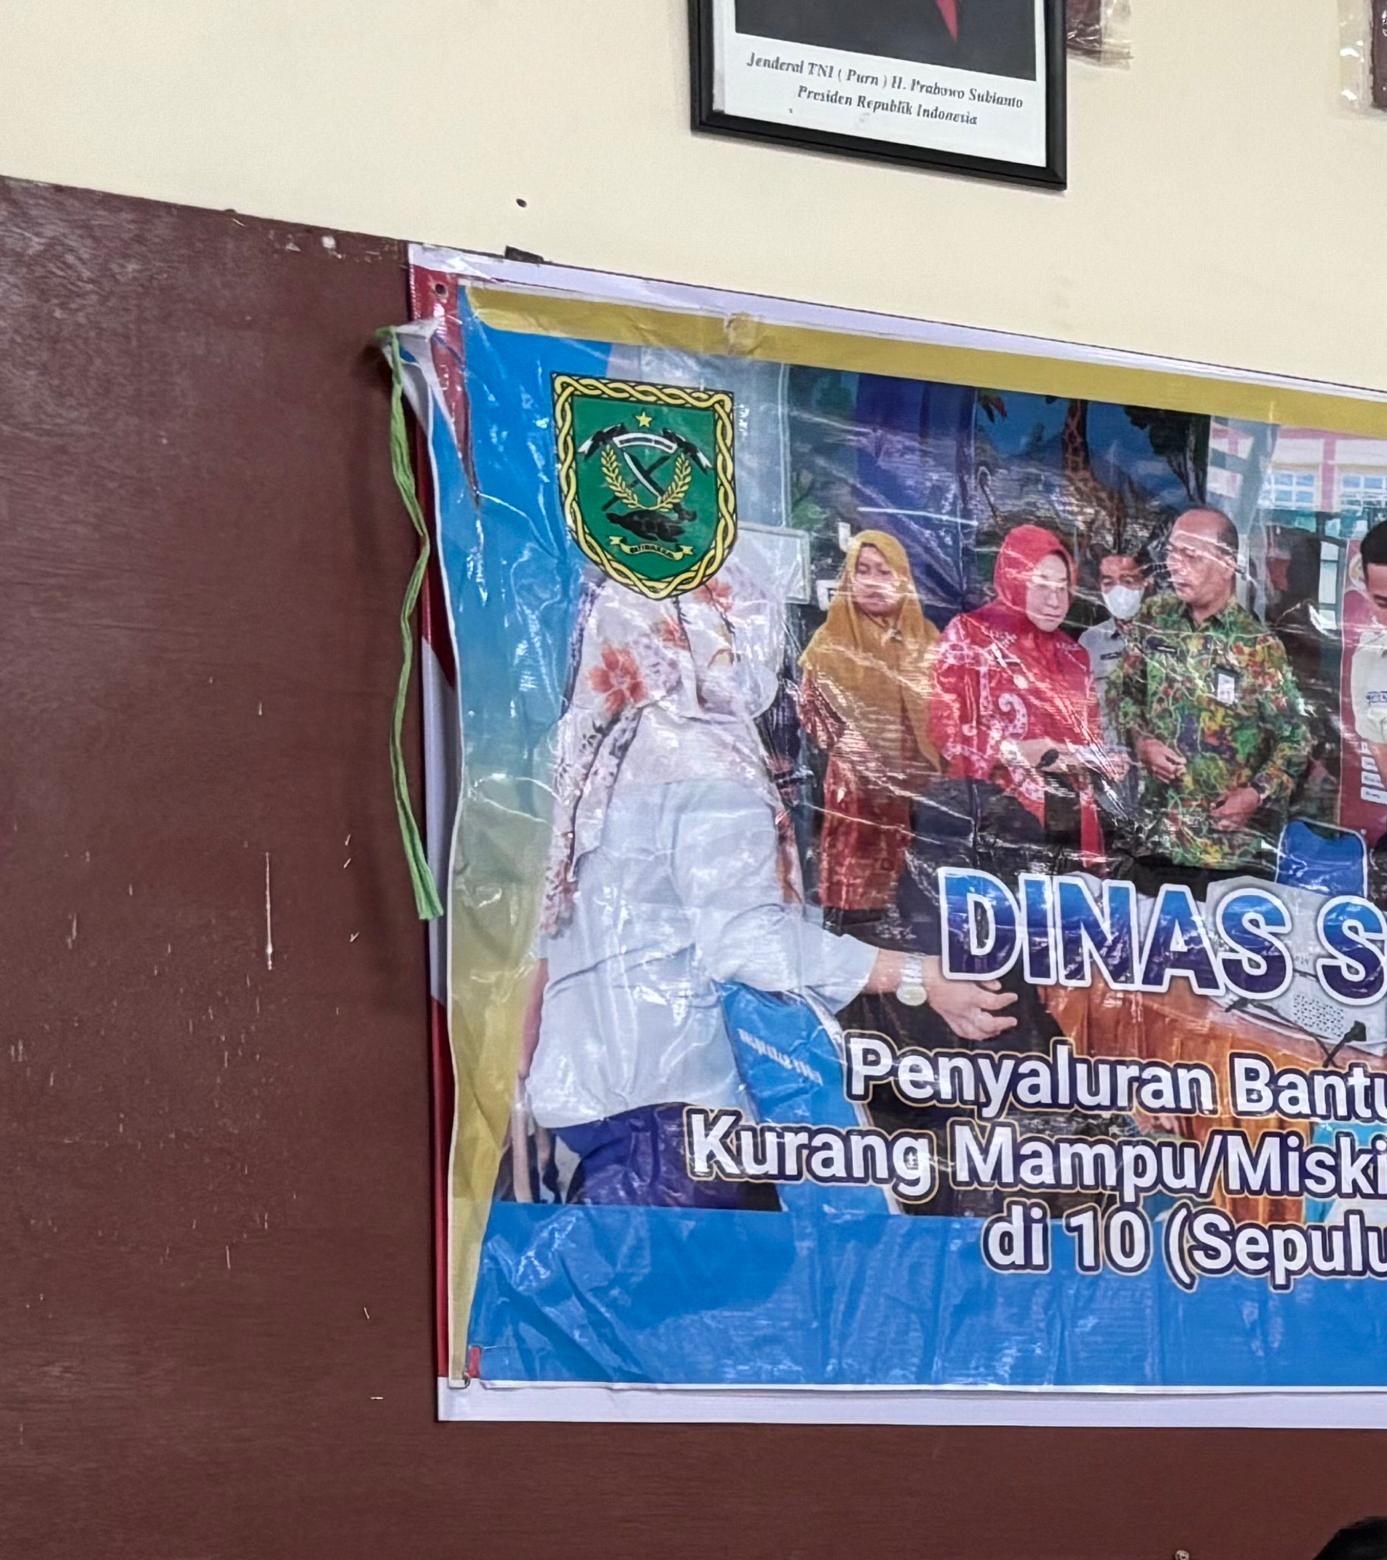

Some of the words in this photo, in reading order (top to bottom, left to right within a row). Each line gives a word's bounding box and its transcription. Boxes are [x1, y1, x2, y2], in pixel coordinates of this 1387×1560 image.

[746, 52, 804, 74] Jenderal
[808, 62, 834, 78] TNI
[911, 79, 965, 99] Prabowo
[969, 87, 1023, 108] Subianto
[797, 85, 853, 106] Presiden
[857, 95, 913, 116] Republik
[917, 104, 978, 125] Indonesia
[939, 866, 1294, 998] DINAS
[848, 1030, 1211, 1118] Penyaluran
[689, 1110, 934, 1198] Kurang
[985, 1203, 1050, 1270] di
[1067, 1208, 1151, 1273] 10
